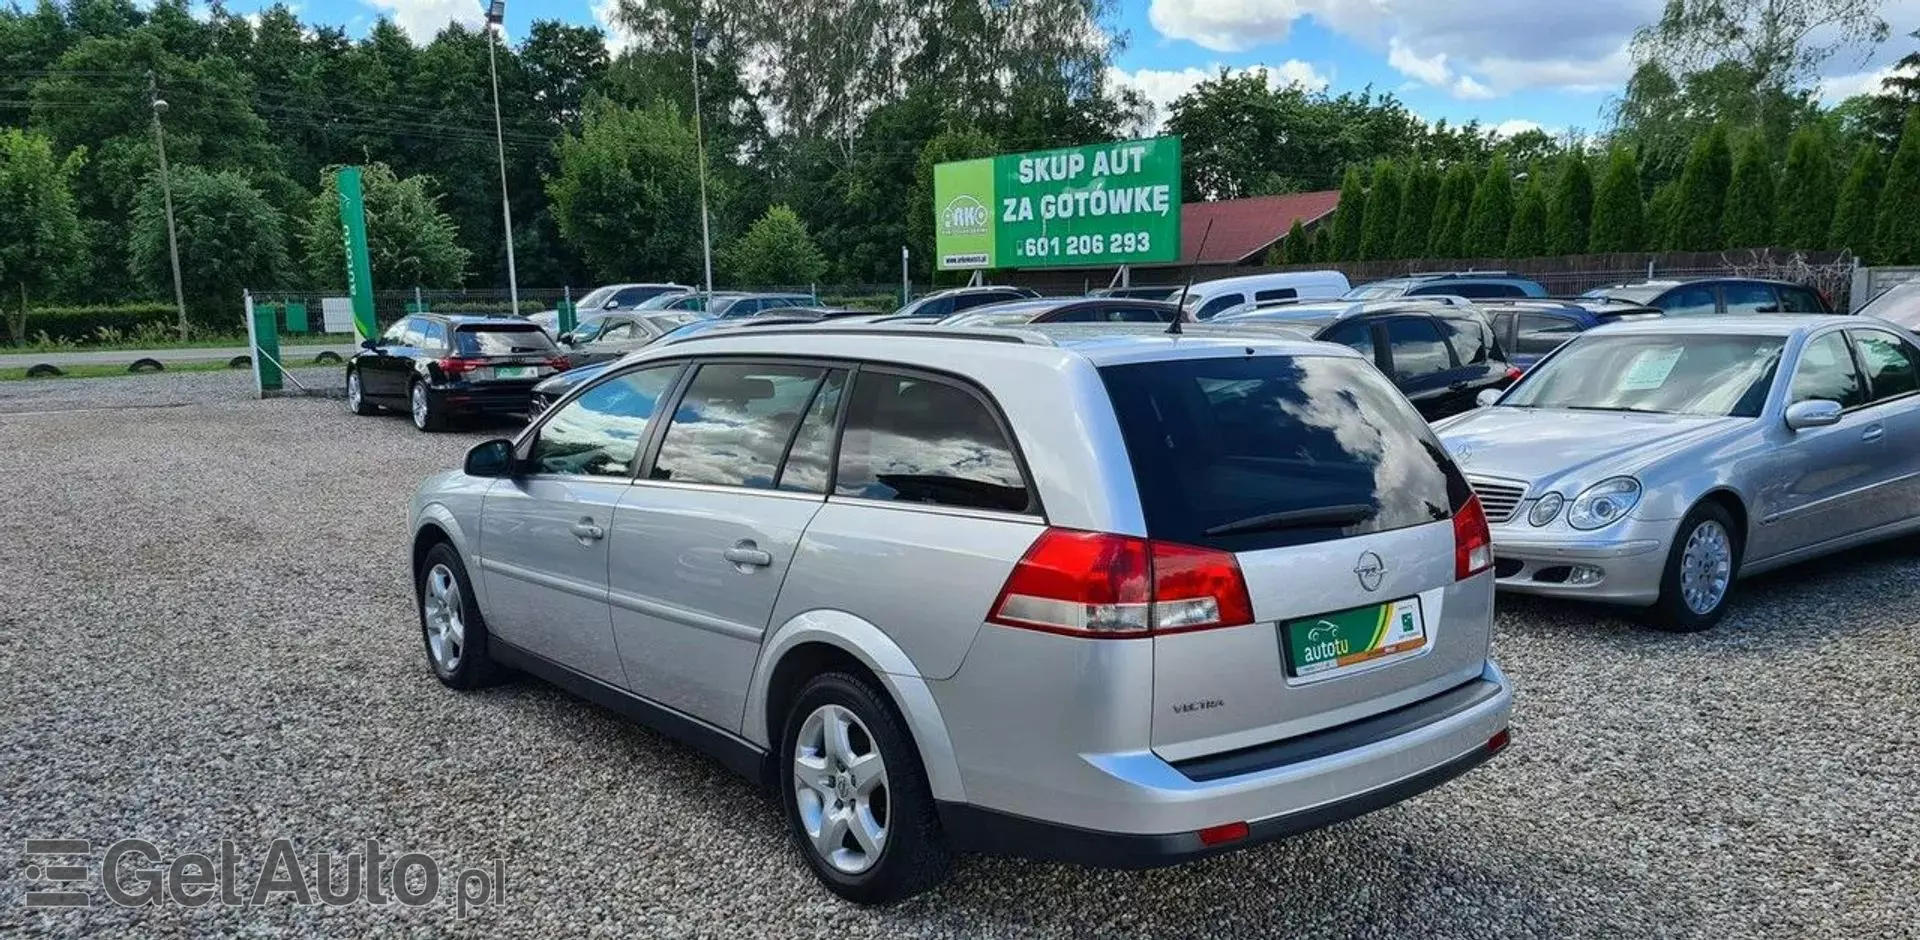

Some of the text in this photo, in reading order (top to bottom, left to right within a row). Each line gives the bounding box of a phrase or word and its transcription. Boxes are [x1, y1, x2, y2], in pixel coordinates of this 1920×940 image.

[1019, 146, 1146, 183] SKUP AUT
[1003, 182, 1170, 222] ZA GOTÓWKĘ
[1025, 232, 1150, 256] 601 206 293
[1304, 638, 1349, 662] autotu
[1172, 699, 1224, 714] VECTRA
